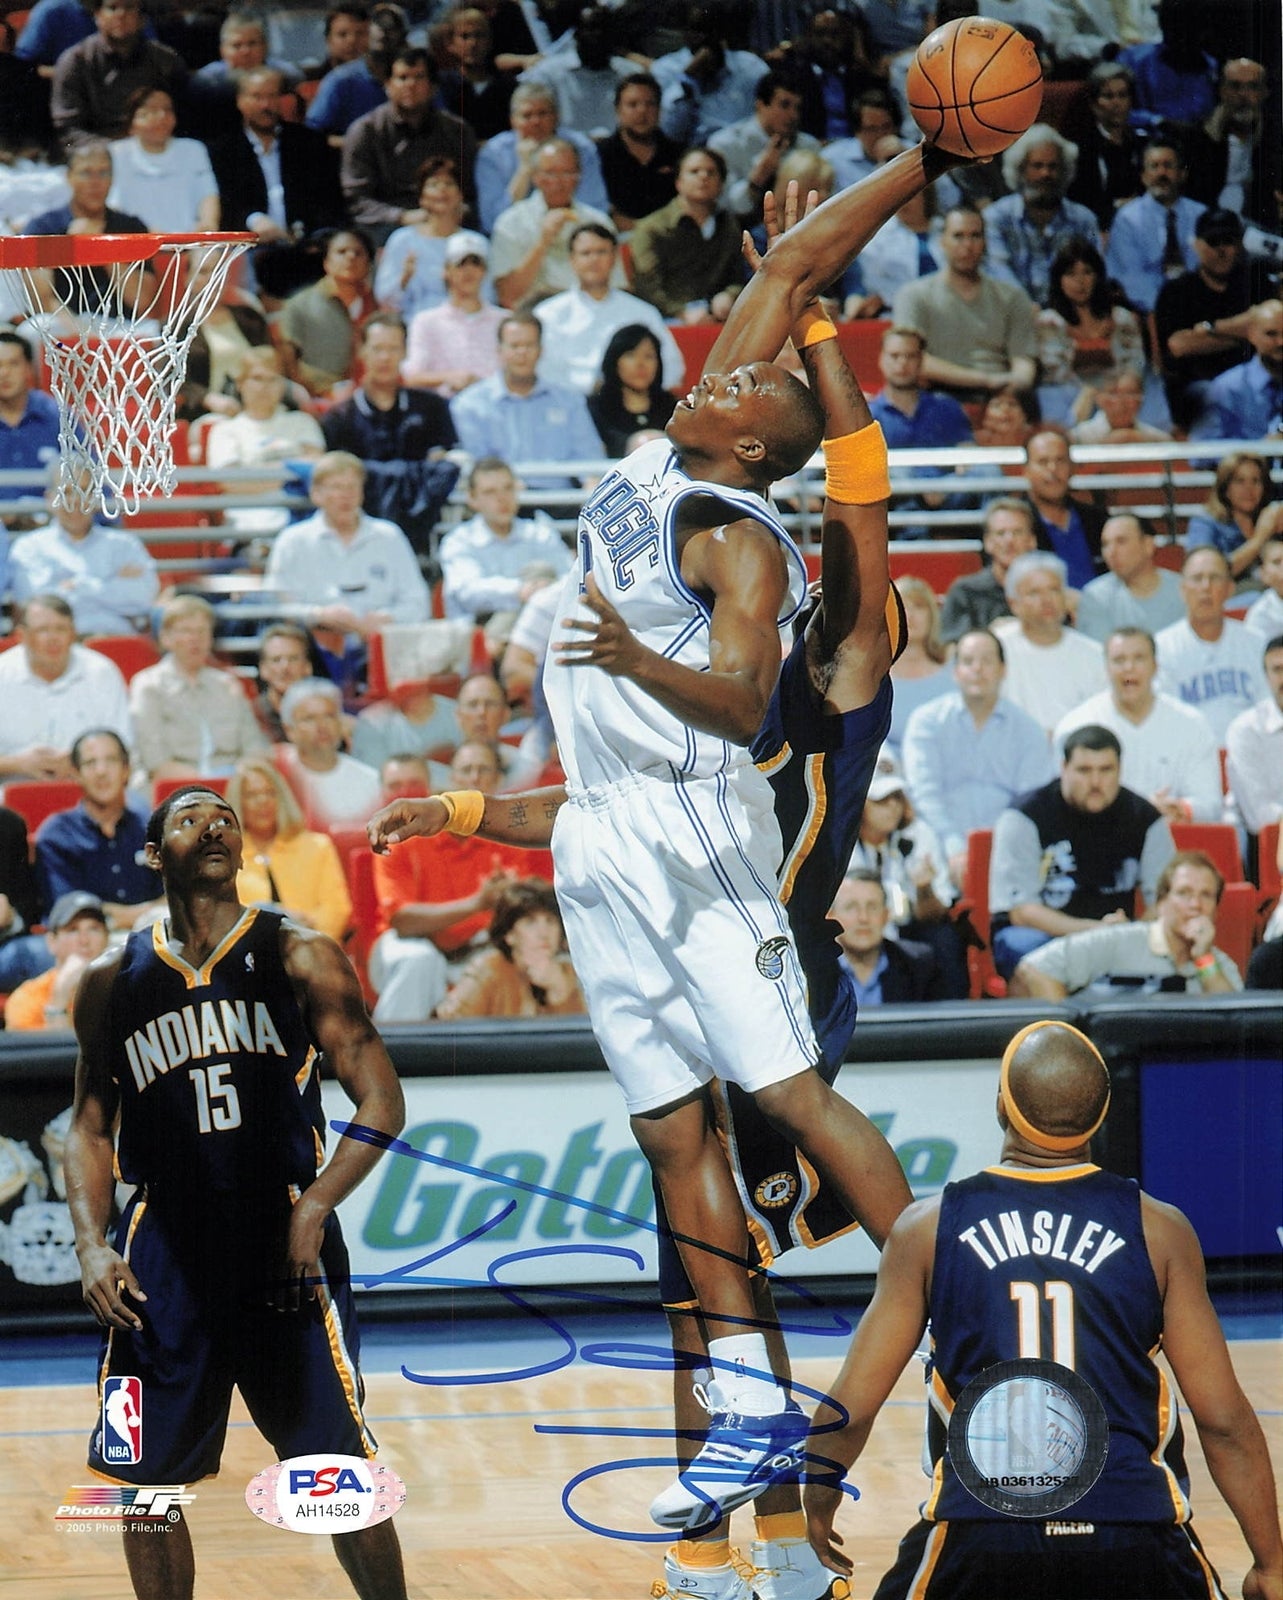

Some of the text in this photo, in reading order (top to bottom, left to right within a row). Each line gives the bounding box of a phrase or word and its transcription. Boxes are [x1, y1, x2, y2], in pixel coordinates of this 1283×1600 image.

[1180, 667, 1256, 704] MAGIC
[124, 1000, 288, 1093] INDIANA
[189, 1063, 242, 1134] 15
[958, 1210, 1126, 1274] TINSLEY
[1010, 1280, 1076, 1373] 11
